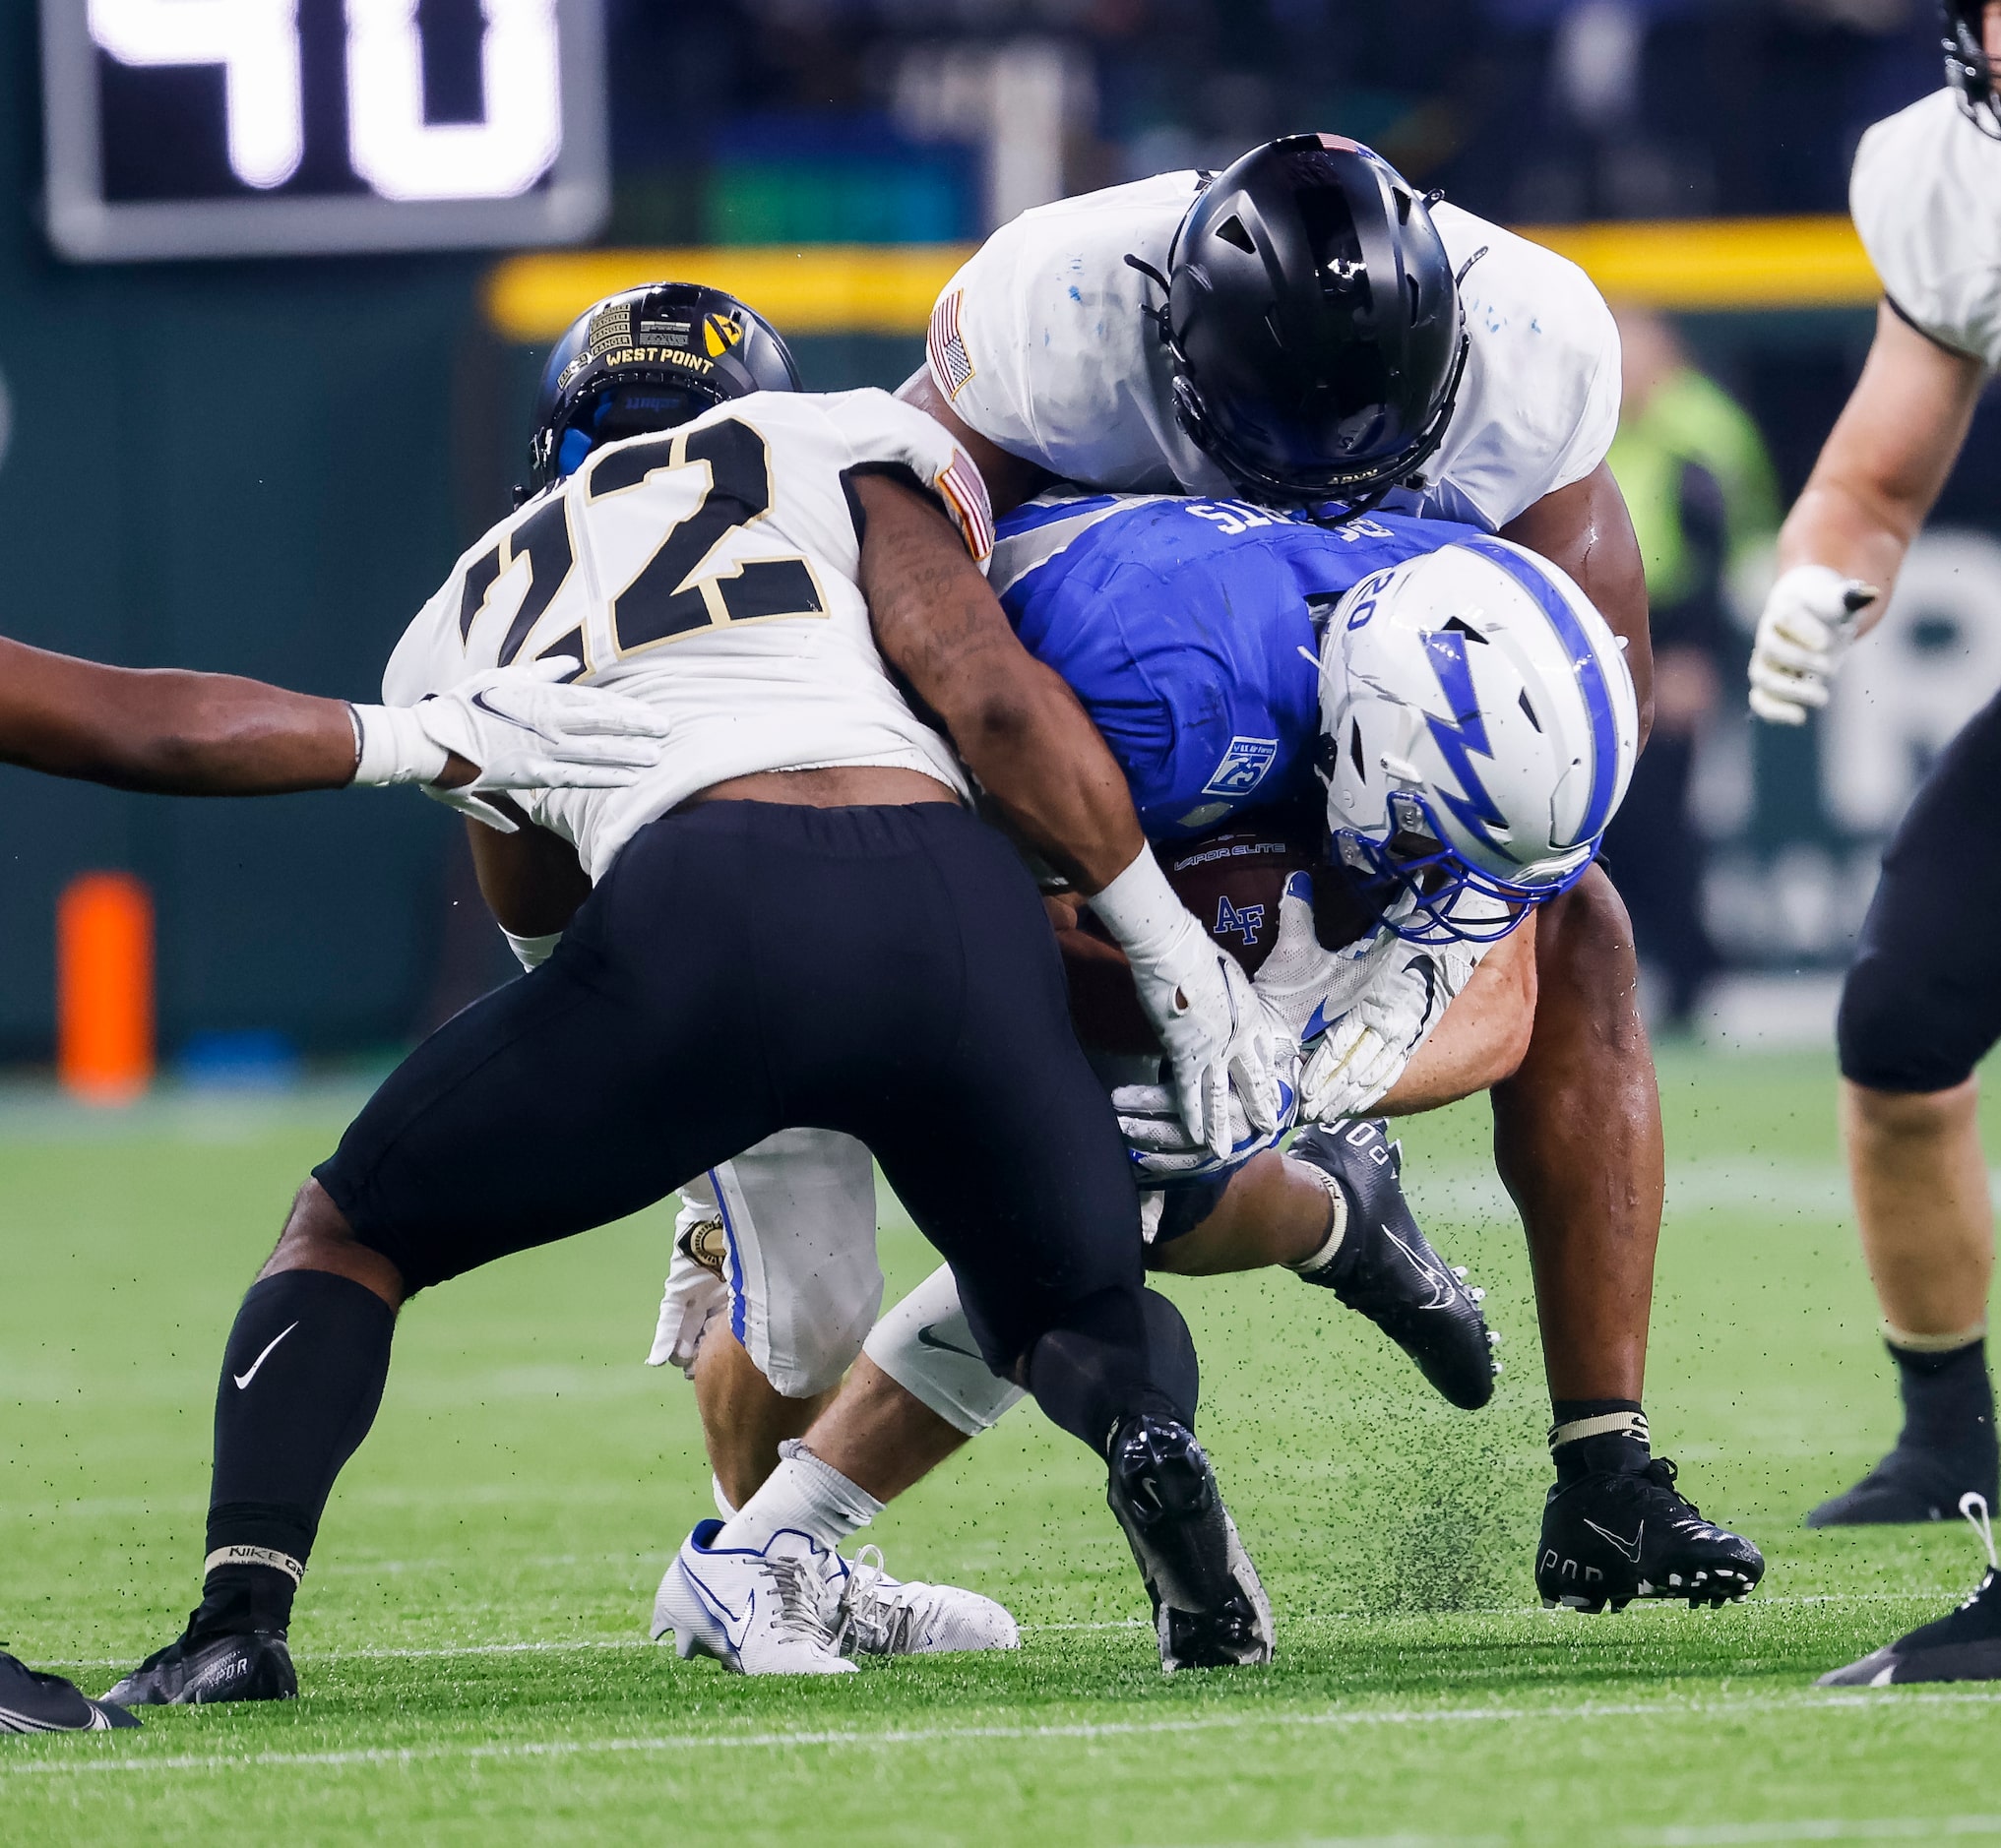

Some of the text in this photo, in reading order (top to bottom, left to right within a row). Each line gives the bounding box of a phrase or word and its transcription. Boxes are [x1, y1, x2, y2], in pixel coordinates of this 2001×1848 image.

[594, 337, 630, 356] RANGER
[605, 347, 715, 375] WEST POINT
[459, 414, 831, 686] 22
[1347, 572, 1396, 632] 20
[1174, 843, 1285, 871] VAPOR ELITE
[1214, 895, 1265, 945] AF
[228, 1547, 278, 1562] NIKE
